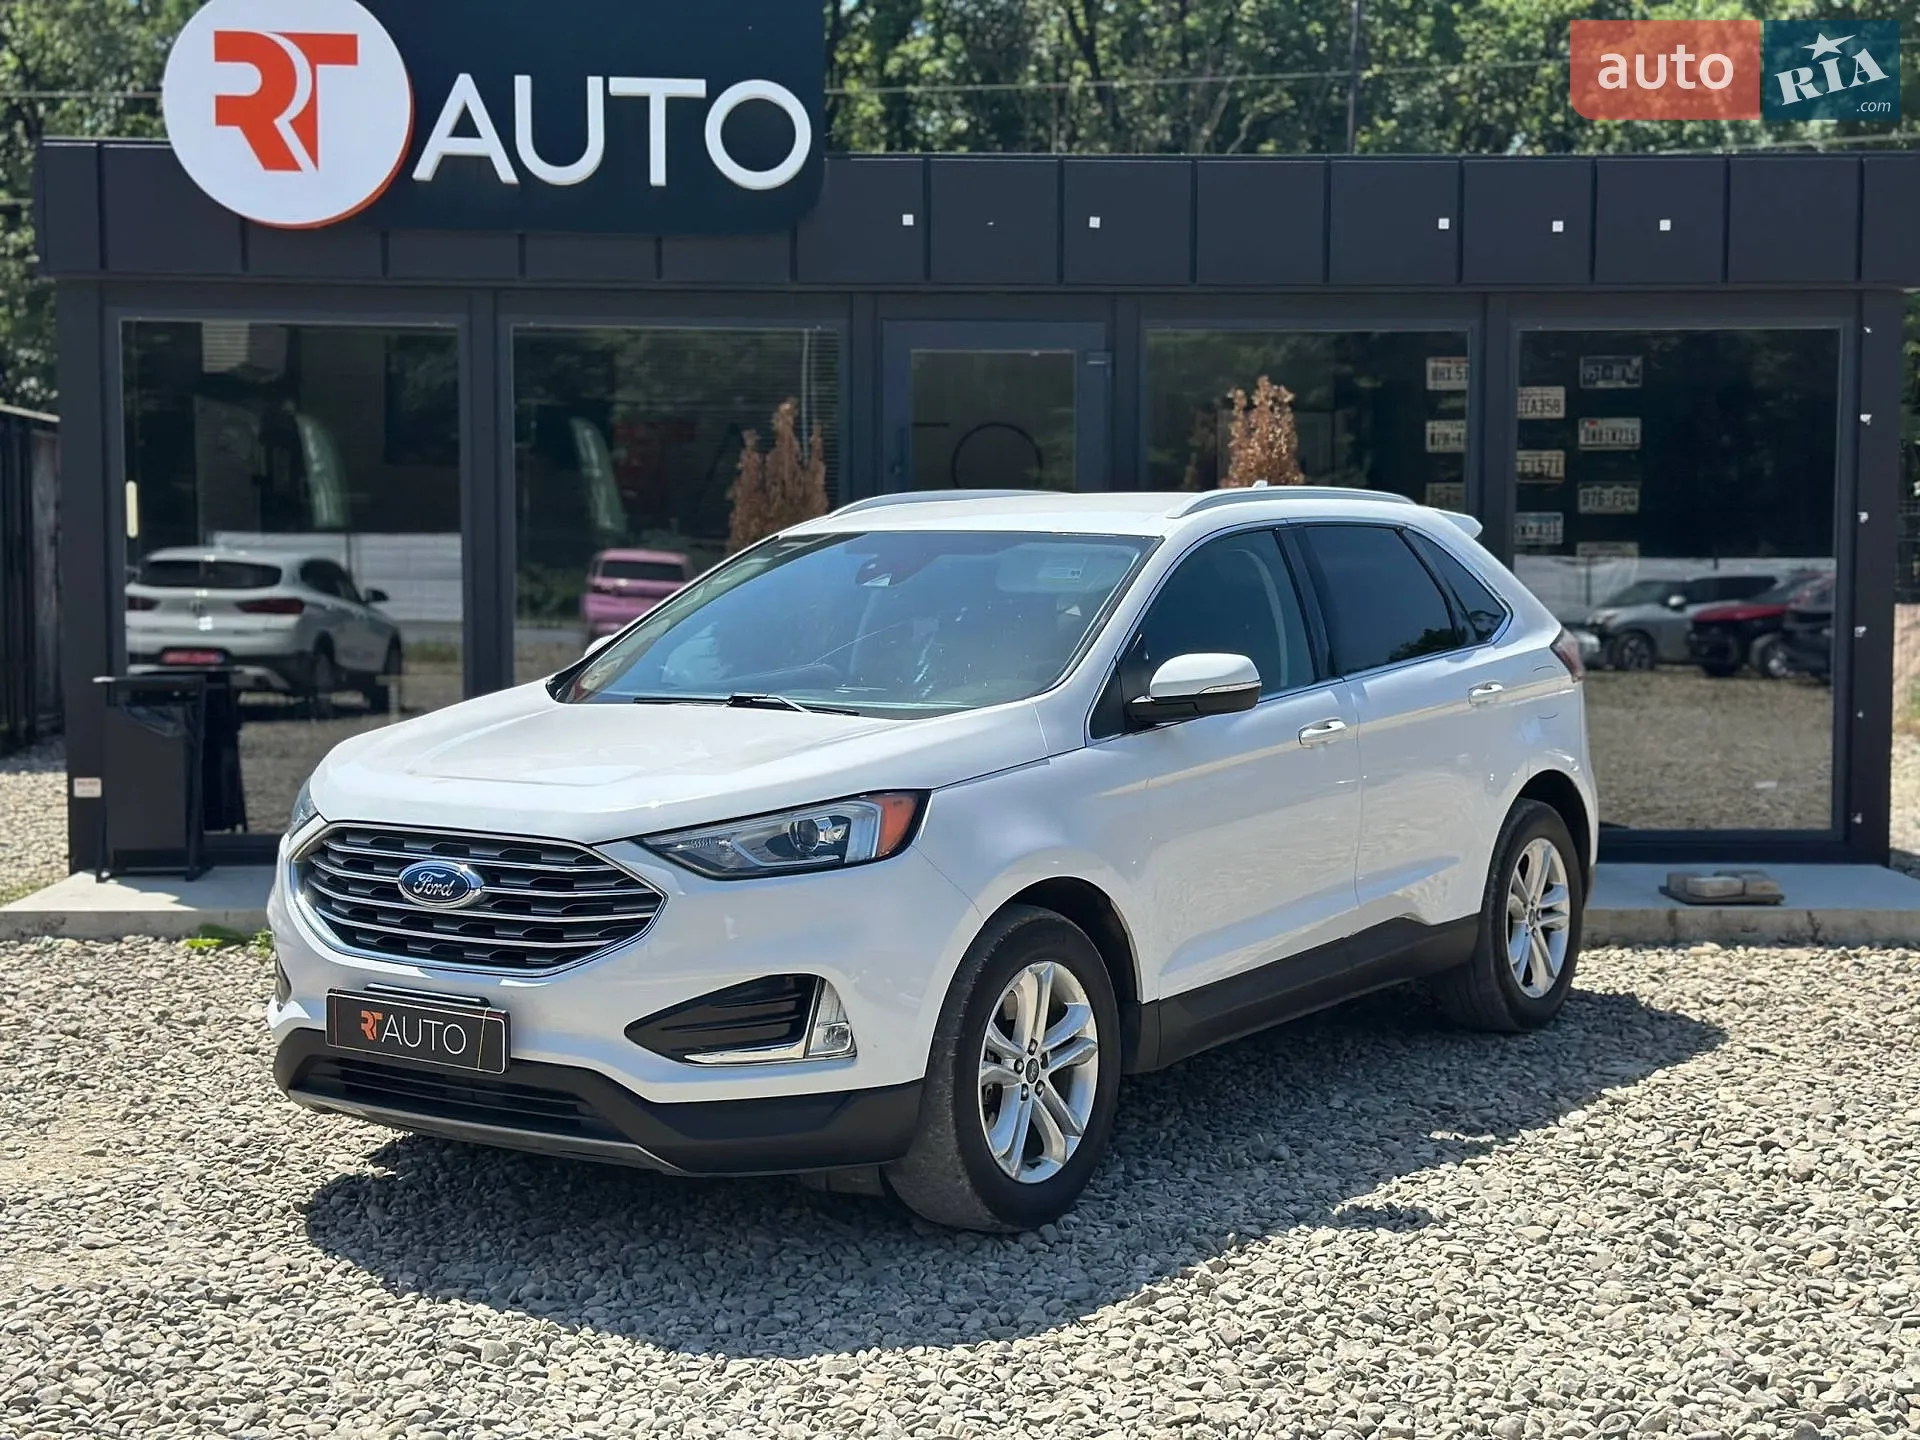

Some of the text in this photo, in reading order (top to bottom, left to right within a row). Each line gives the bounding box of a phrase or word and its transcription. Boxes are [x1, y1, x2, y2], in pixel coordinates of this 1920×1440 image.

[214, 30, 811, 190] RT AUTO
[412, 871, 457, 897] Ford
[360, 1010, 467, 1055] RT AUTO
